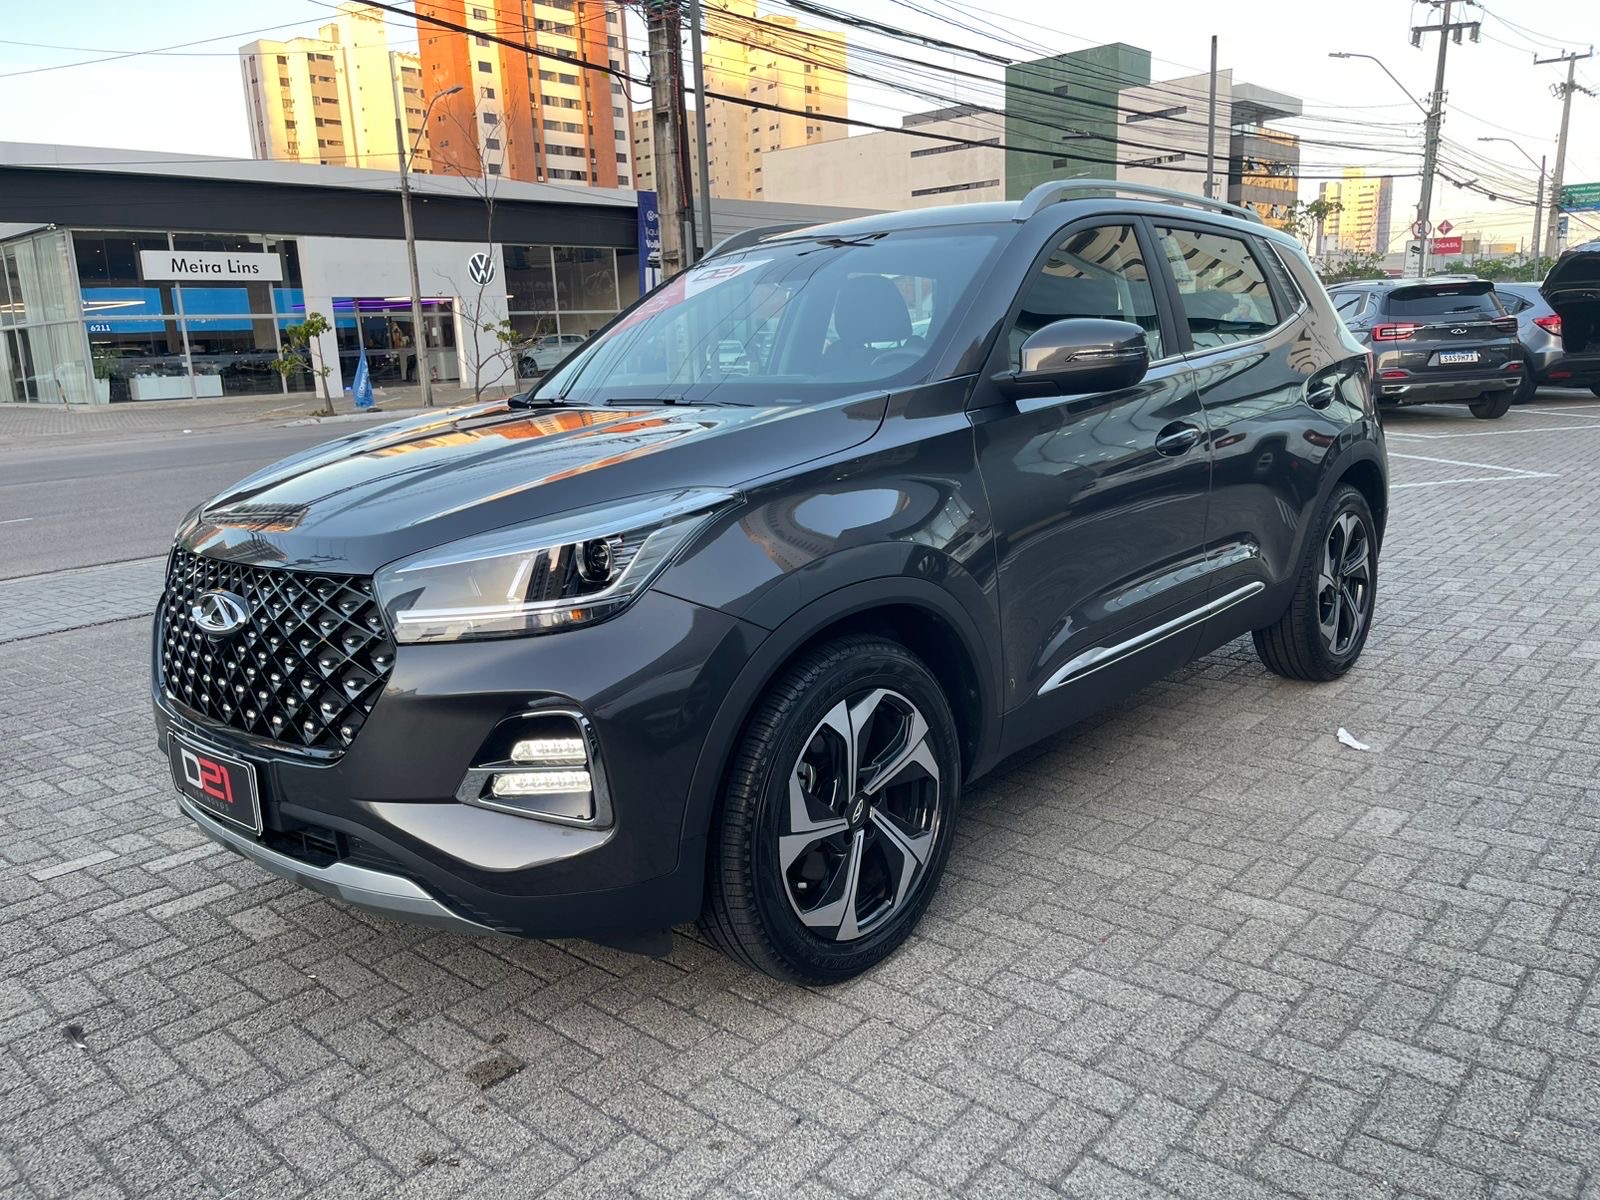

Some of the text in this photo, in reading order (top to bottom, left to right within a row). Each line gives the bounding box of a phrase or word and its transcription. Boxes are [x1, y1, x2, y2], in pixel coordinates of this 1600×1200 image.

[171, 258, 260, 275] Meira Lins
[90, 324, 111, 332] 6211
[181, 748, 234, 804] D21
